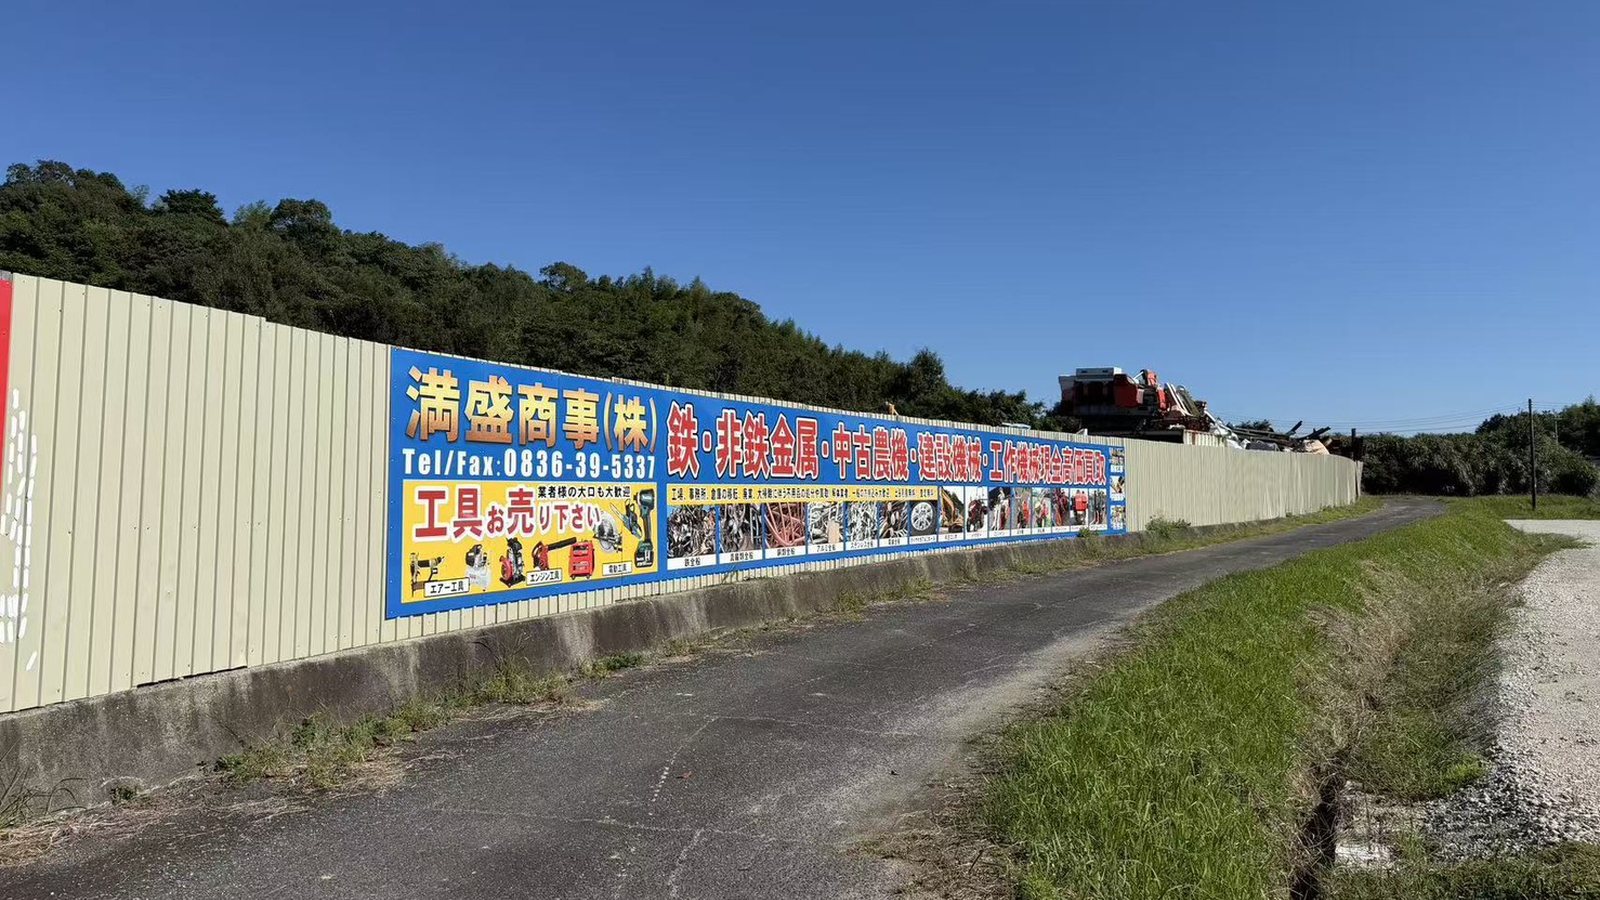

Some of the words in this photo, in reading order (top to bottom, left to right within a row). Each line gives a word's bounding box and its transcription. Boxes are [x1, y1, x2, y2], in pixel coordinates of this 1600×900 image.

[537, 485, 631, 499] 業者様の大口も大歓迎
[414, 487, 602, 539] 工具お売り下さい
[530, 570, 560, 582] エンジン工具
[430, 580, 465, 594] エアー工具
